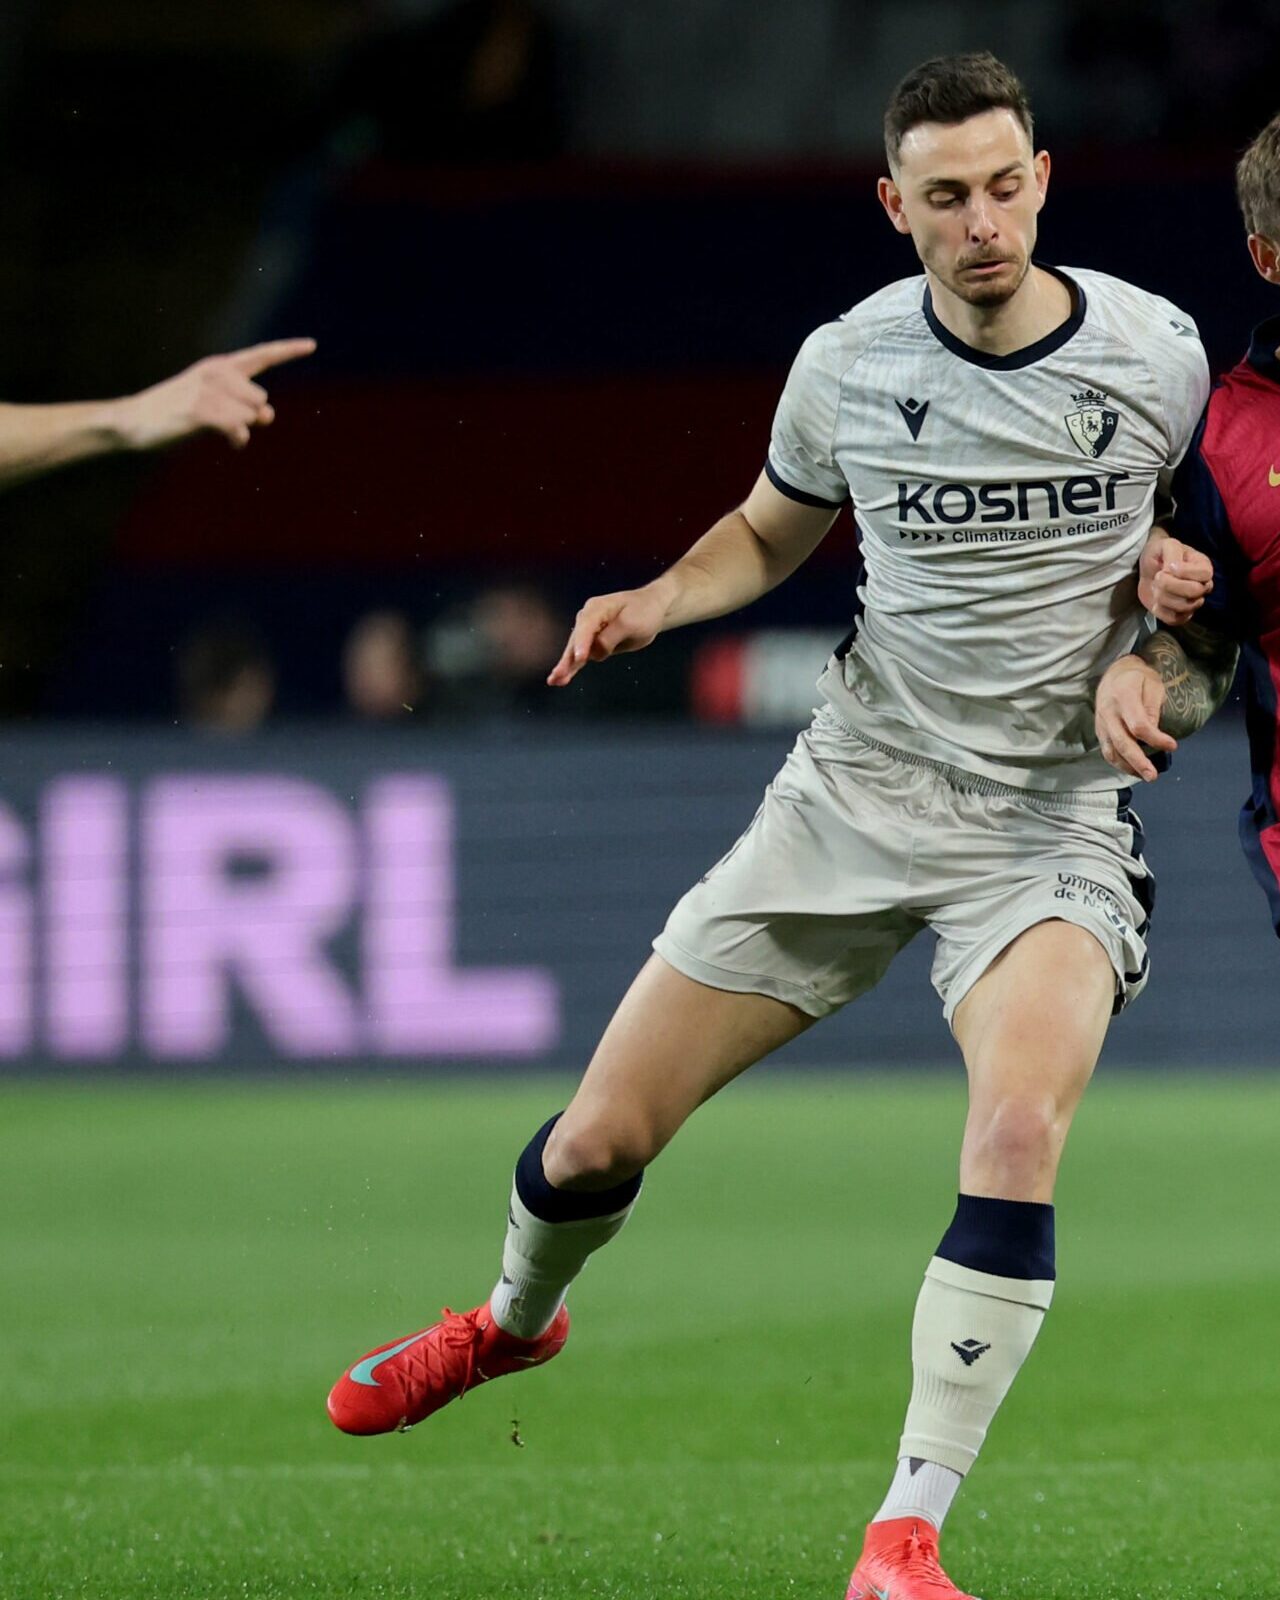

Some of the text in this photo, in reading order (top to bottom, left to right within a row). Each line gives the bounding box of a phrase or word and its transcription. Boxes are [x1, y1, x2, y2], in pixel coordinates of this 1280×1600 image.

[898, 473, 1129, 524] Kosner
[952, 513, 1130, 543] Climatización eficiente
[1054, 888, 1077, 901] de
